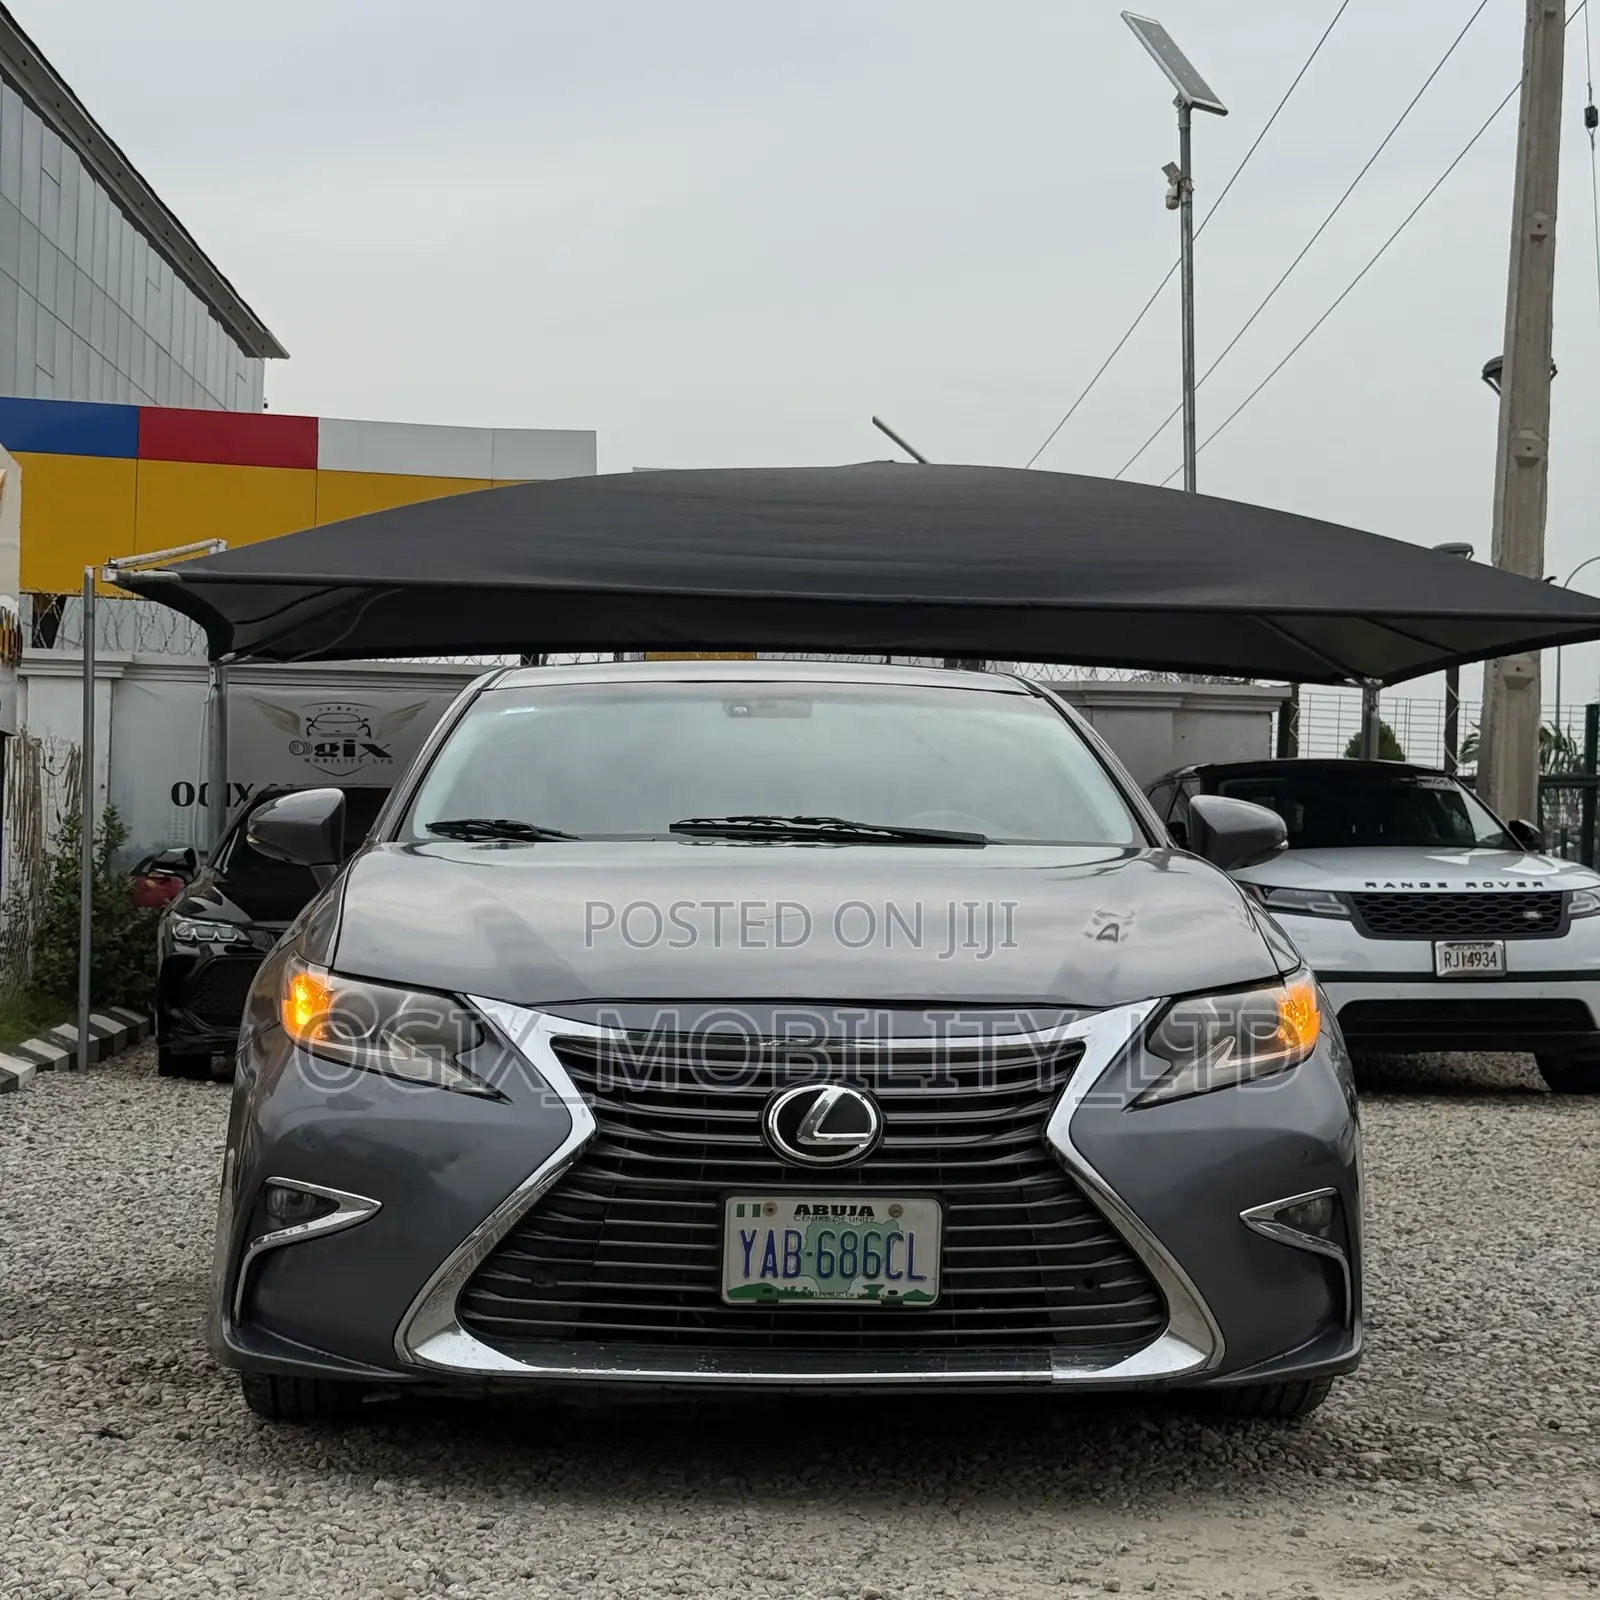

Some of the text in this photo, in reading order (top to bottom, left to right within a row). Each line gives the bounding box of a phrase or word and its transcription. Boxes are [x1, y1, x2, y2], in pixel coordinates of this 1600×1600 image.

[1365, 881, 1448, 889] RANGE
[794, 1204, 876, 1217] ABUJA
[739, 1229, 928, 1281] YAB-686CL
